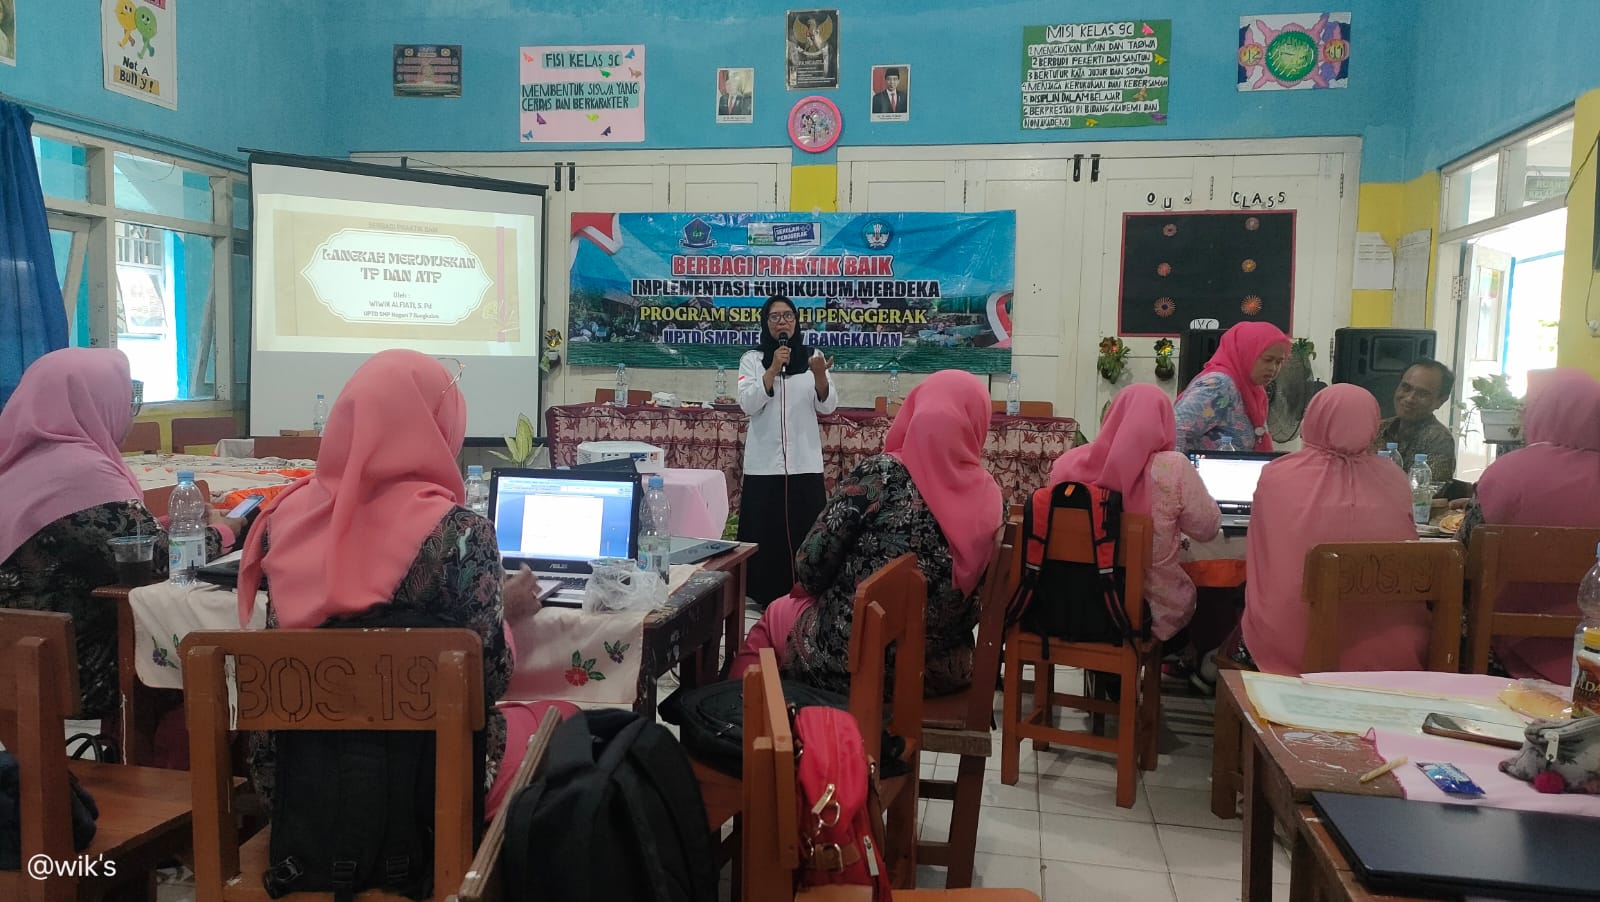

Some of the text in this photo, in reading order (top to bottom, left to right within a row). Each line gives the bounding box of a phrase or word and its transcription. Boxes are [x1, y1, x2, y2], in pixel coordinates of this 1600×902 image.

[1047, 25, 1074, 39] MISI
[1080, 24, 1115, 38] KELAS
[1108, 41, 1124, 51] DAN
[122, 56, 150, 77] Not A
[545, 53, 620, 68] FISI KELAS 9C
[1106, 55, 1121, 63] DAN
[1109, 67, 1124, 76] DAN
[521, 81, 638, 97] MEMBENTUK SISWA YANG
[555, 98, 571, 110] DAN
[1232, 191, 1286, 208] CLASS
[388, 252, 476, 269] MERUMUSKAN
[673, 255, 893, 276] BERBAGI PRAKTIK BAIK
[360, 267, 443, 283] TP DAN ATP
[632, 279, 940, 298] IMPLEMENTASI KURIKULUM MERDEKA
[640, 306, 928, 324] PROGRAM SEKH PENGGERAK
[663, 328, 701, 345] UPTD
[705, 329, 738, 345] SMP
[808, 332, 902, 347] BANGKALAN
